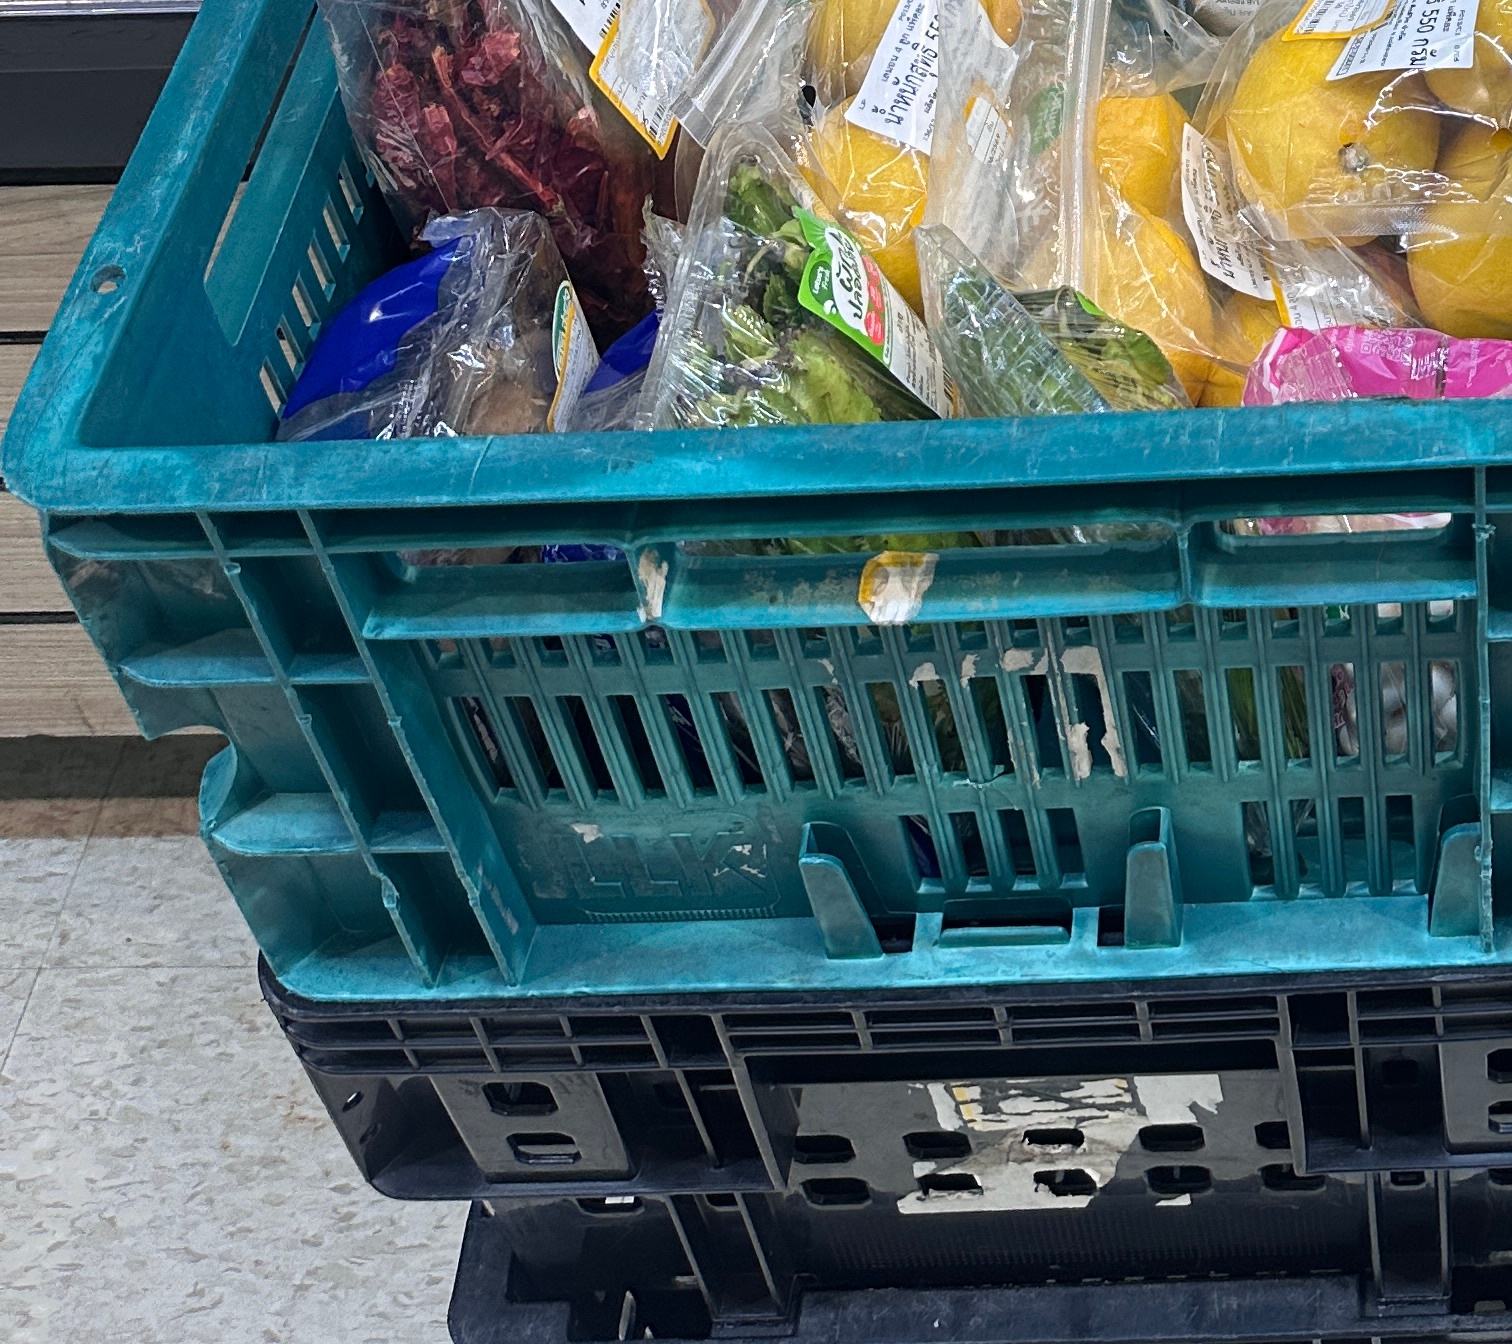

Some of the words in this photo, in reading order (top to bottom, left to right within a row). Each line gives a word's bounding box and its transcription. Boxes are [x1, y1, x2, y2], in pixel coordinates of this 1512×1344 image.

[1415, 7, 1439, 35] 550
[898, 31, 913, 46] ลูก
[1408, 36, 1438, 70] กรัม
[872, 42, 940, 126] น้ำหนักสุทธิ
